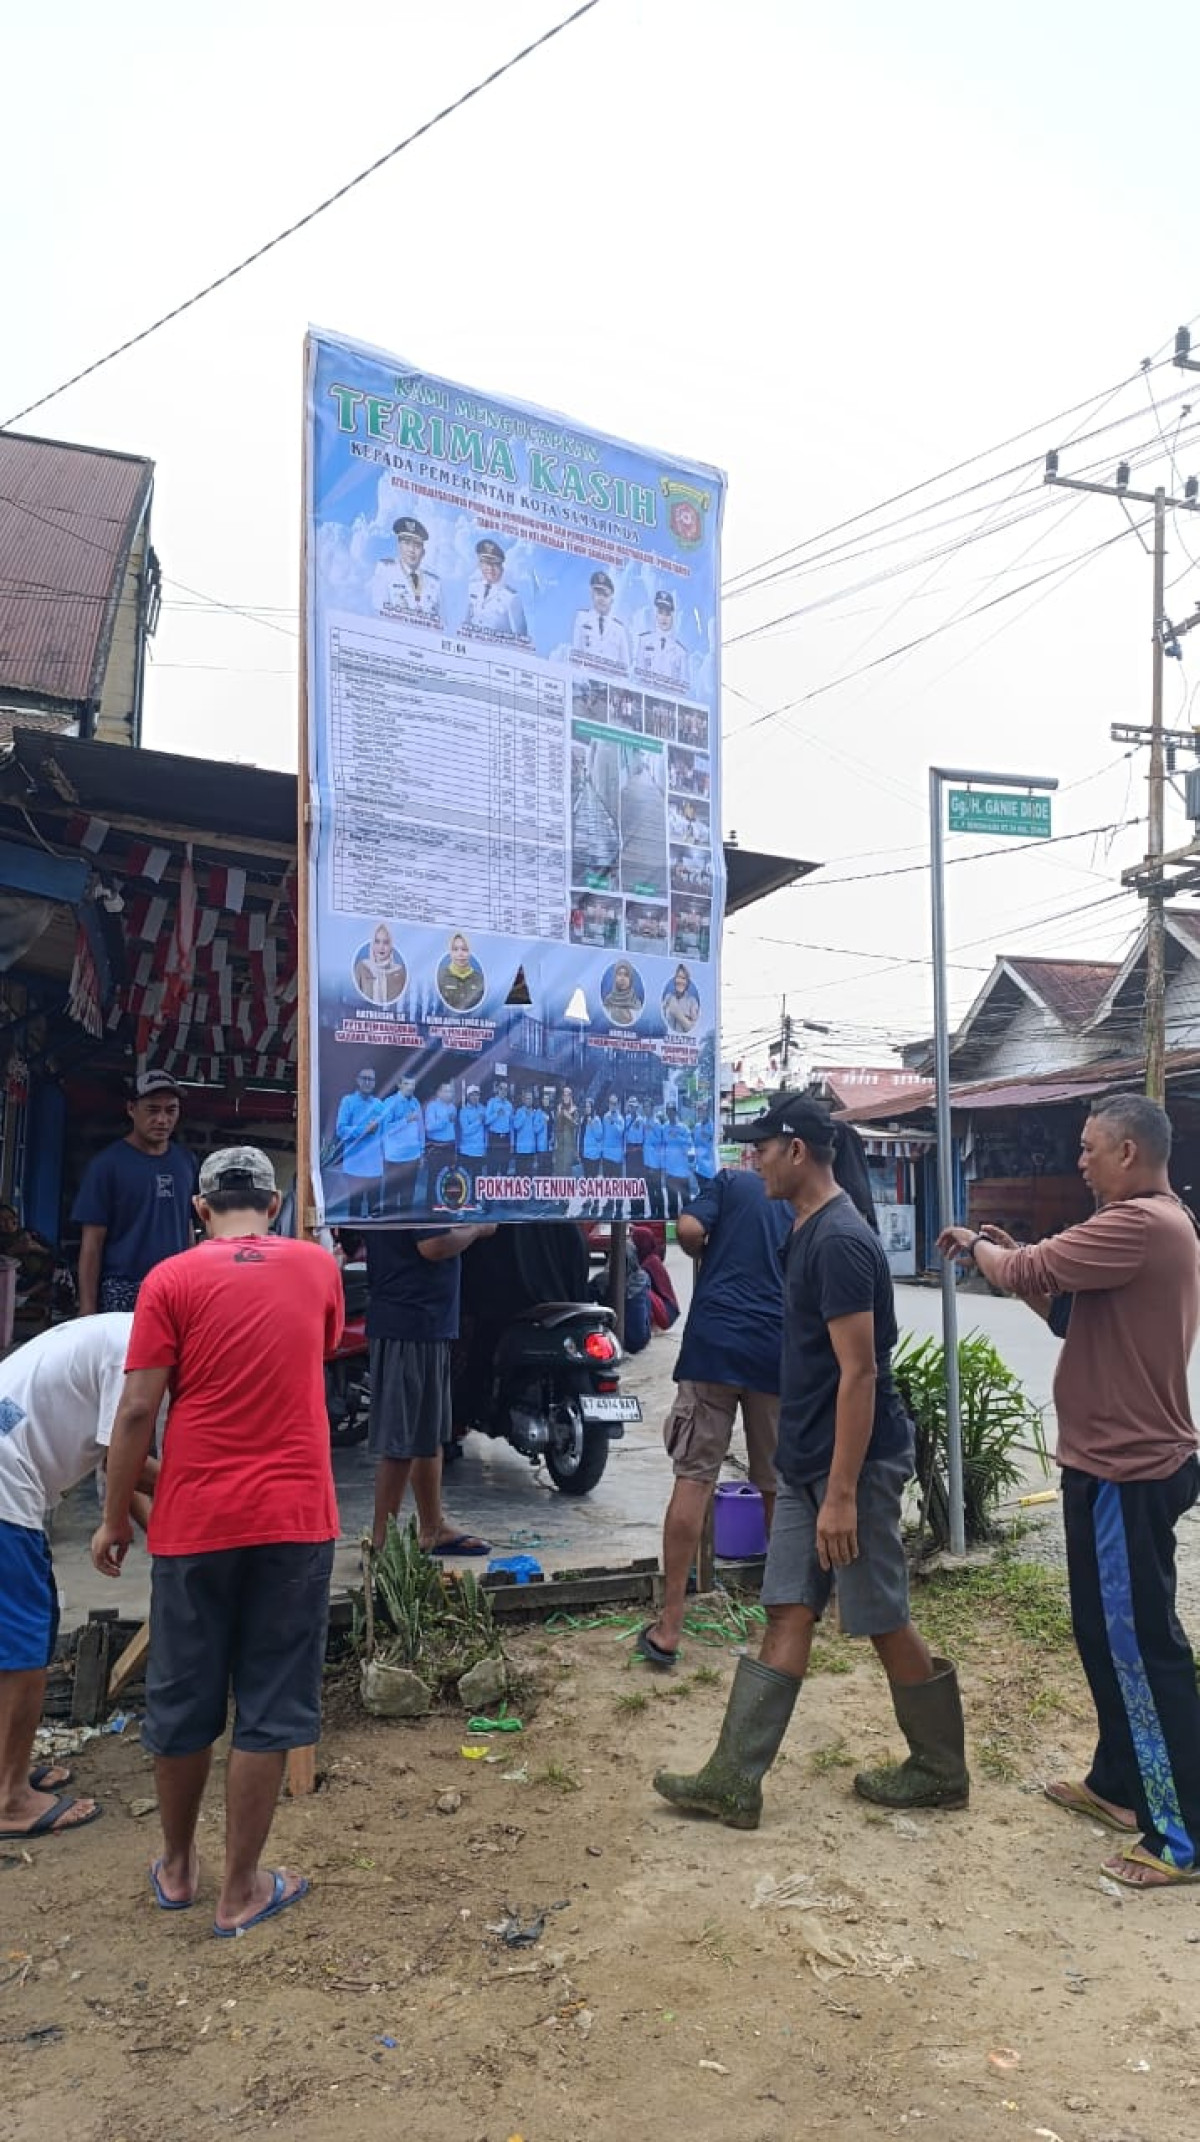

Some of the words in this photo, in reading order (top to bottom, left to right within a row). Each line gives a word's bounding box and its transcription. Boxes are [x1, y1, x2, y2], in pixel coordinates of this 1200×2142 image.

[329, 383, 516, 483] TERIMA
[530, 449, 657, 528] KASIH
[351, 441, 413, 473] KEPADA
[419, 463, 515, 506] PEMERINTAH
[521, 495, 557, 518] KOTA
[562, 507, 640, 543] SAMARINDA
[951, 796, 969, 816] Gg.
[971, 799, 982, 815] H.
[477, 1177, 531, 1198] POKMAS
[534, 1177, 576, 1198] TENUN
[578, 1177, 647, 1198] SAMARINDA
